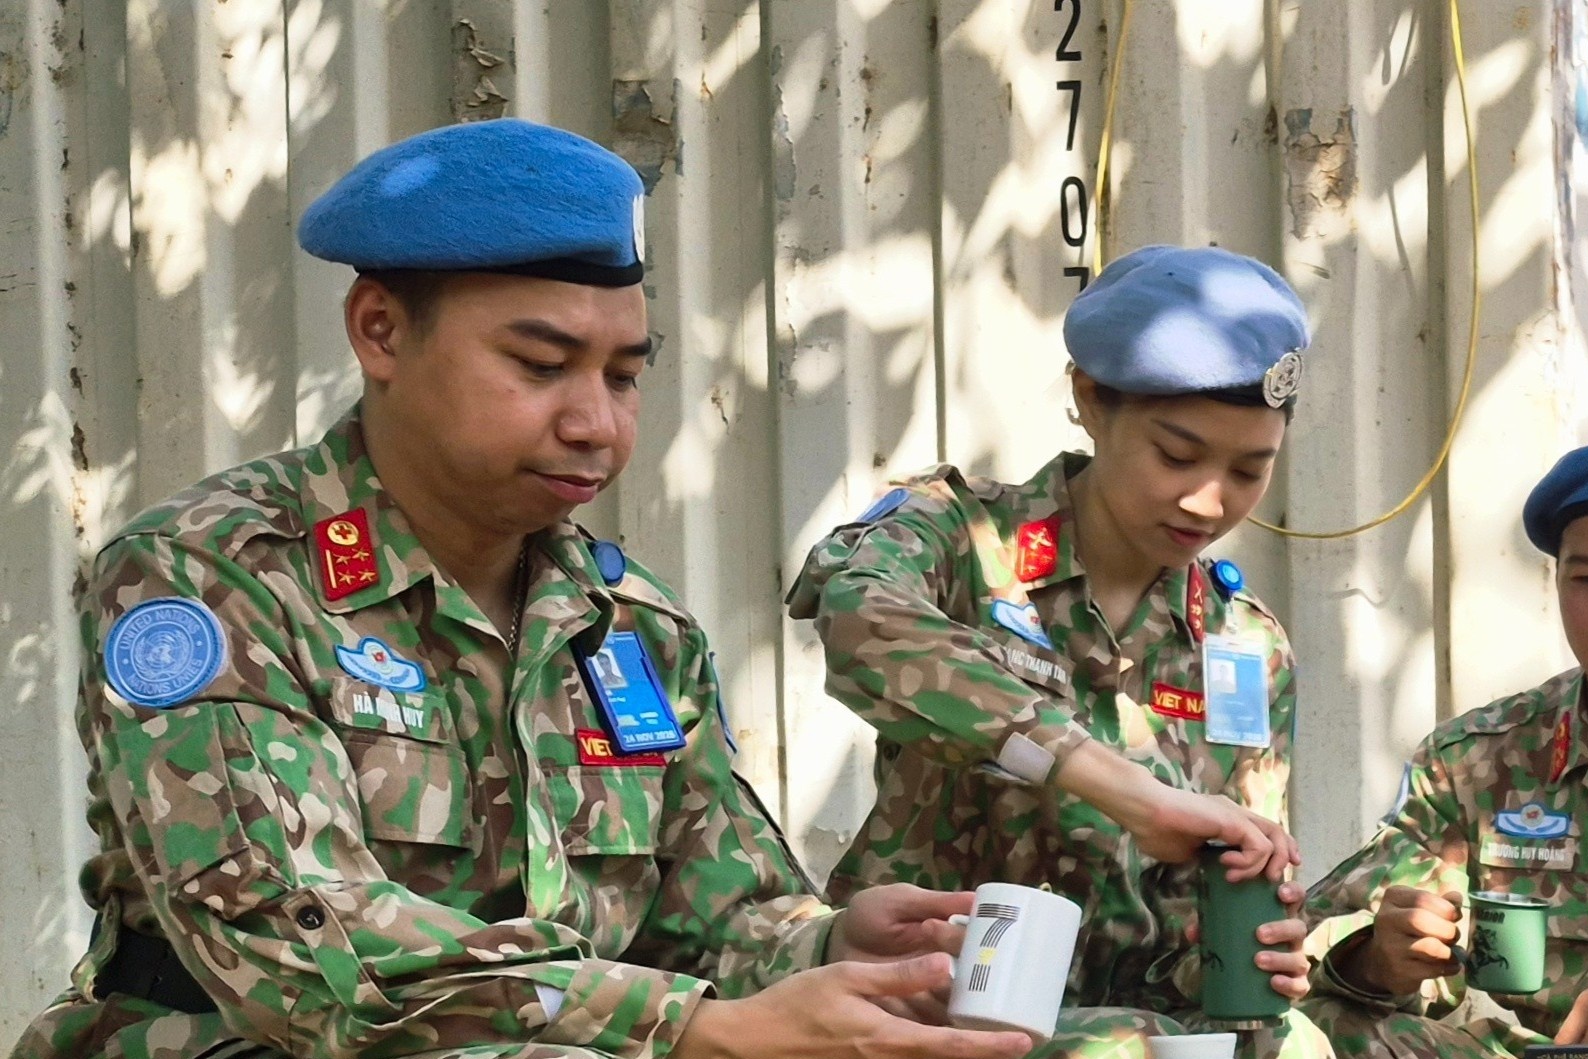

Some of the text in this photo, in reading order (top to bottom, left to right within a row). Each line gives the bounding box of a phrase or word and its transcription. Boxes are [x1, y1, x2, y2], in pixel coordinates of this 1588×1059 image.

[120, 609, 200, 650] UNITED NATIONS
[128, 673, 171, 695] NATIONS
[352, 691, 374, 714] HÀ
[402, 706, 424, 728] HUY
[1154, 690, 1183, 710] VIET
[580, 736, 614, 757] VIET
[1521, 846, 1537, 860] HUY
